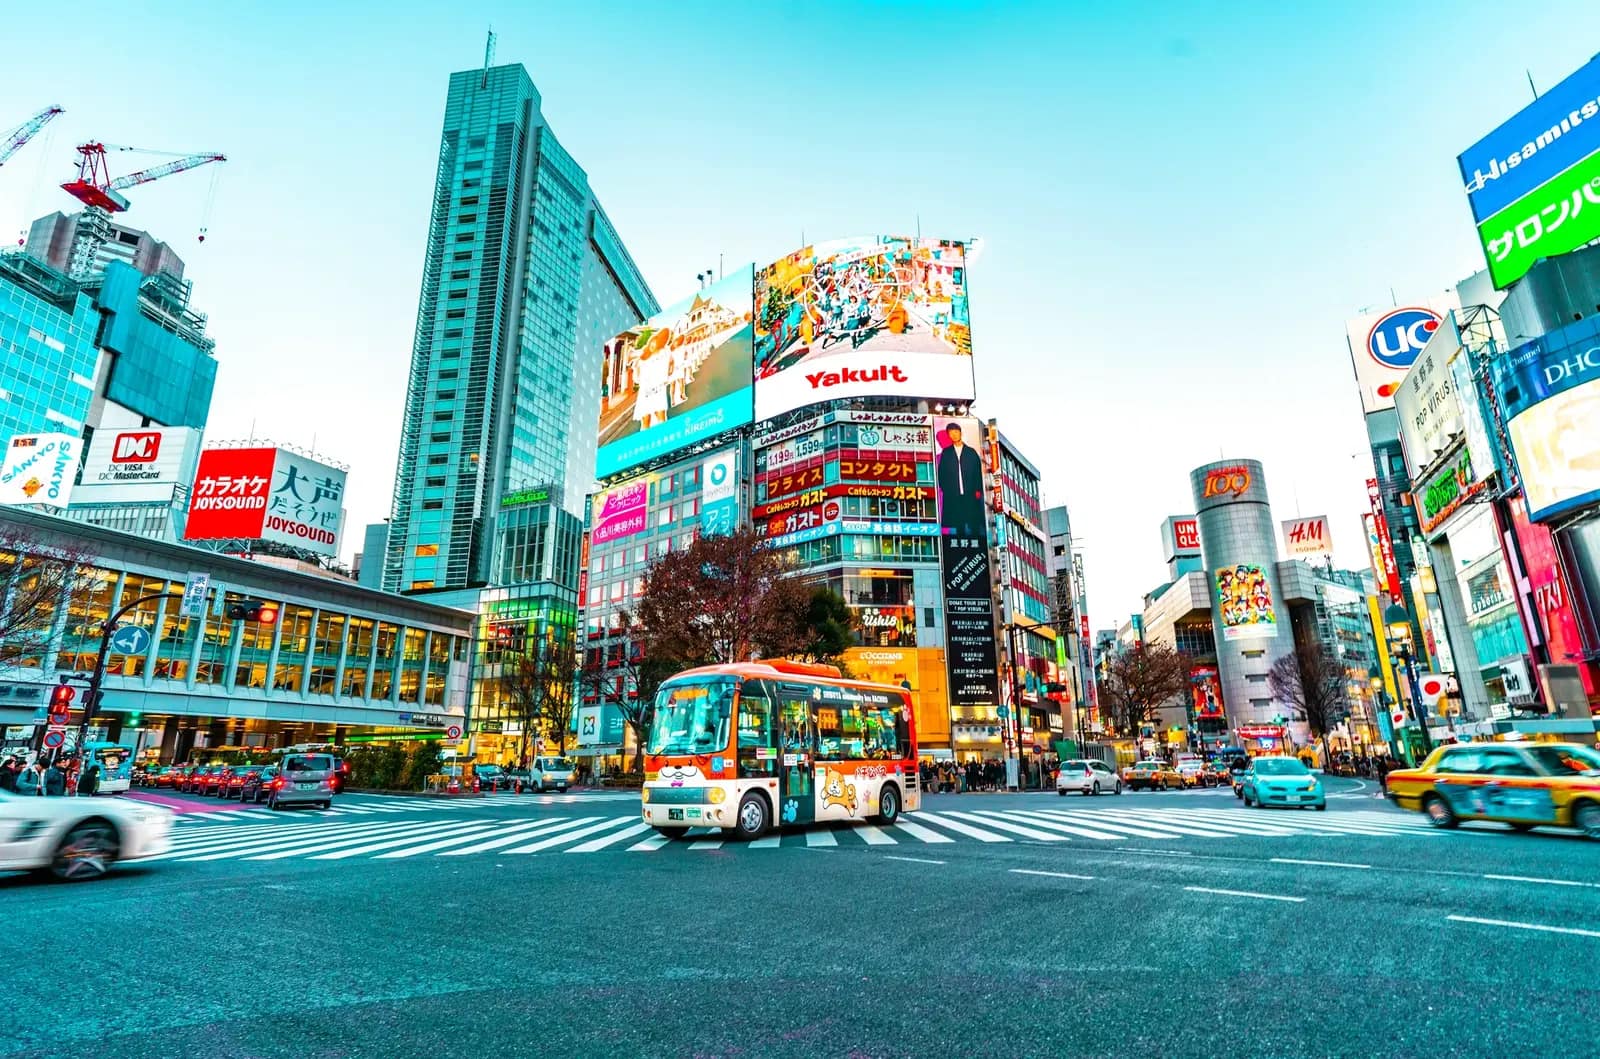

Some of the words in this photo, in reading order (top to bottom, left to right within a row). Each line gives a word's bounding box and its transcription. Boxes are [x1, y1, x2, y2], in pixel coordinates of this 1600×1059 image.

[1466, 95, 1600, 194] Hisamits
[805, 365, 908, 389] Yakult
[1544, 346, 1600, 385] DHC
[117, 436, 155, 459] DC
[883, 430, 928, 444] しゃぶ葉
[2, 441, 56, 483] SANKYO
[47, 440, 72, 499] SANKYO
[756, 456, 767, 466] 9F
[840, 462, 914, 477] コンタクト
[99, 472, 112, 480] DC
[113, 471, 160, 480] MasterCard
[197, 476, 268, 496] カラオケ
[272, 464, 344, 504] 大声
[769, 467, 823, 496] プライス
[1202, 472, 1252, 498] 109
[193, 496, 265, 511] JOYSOUND
[800, 489, 829, 507] ガスト
[893, 486, 928, 500] ガスト
[268, 495, 338, 531] だそうぜ
[784, 510, 820, 534] ガスト
[264, 515, 336, 545] JOYSOUND
[755, 524, 768, 537] 7F
[1289, 519, 1323, 545] H&M
